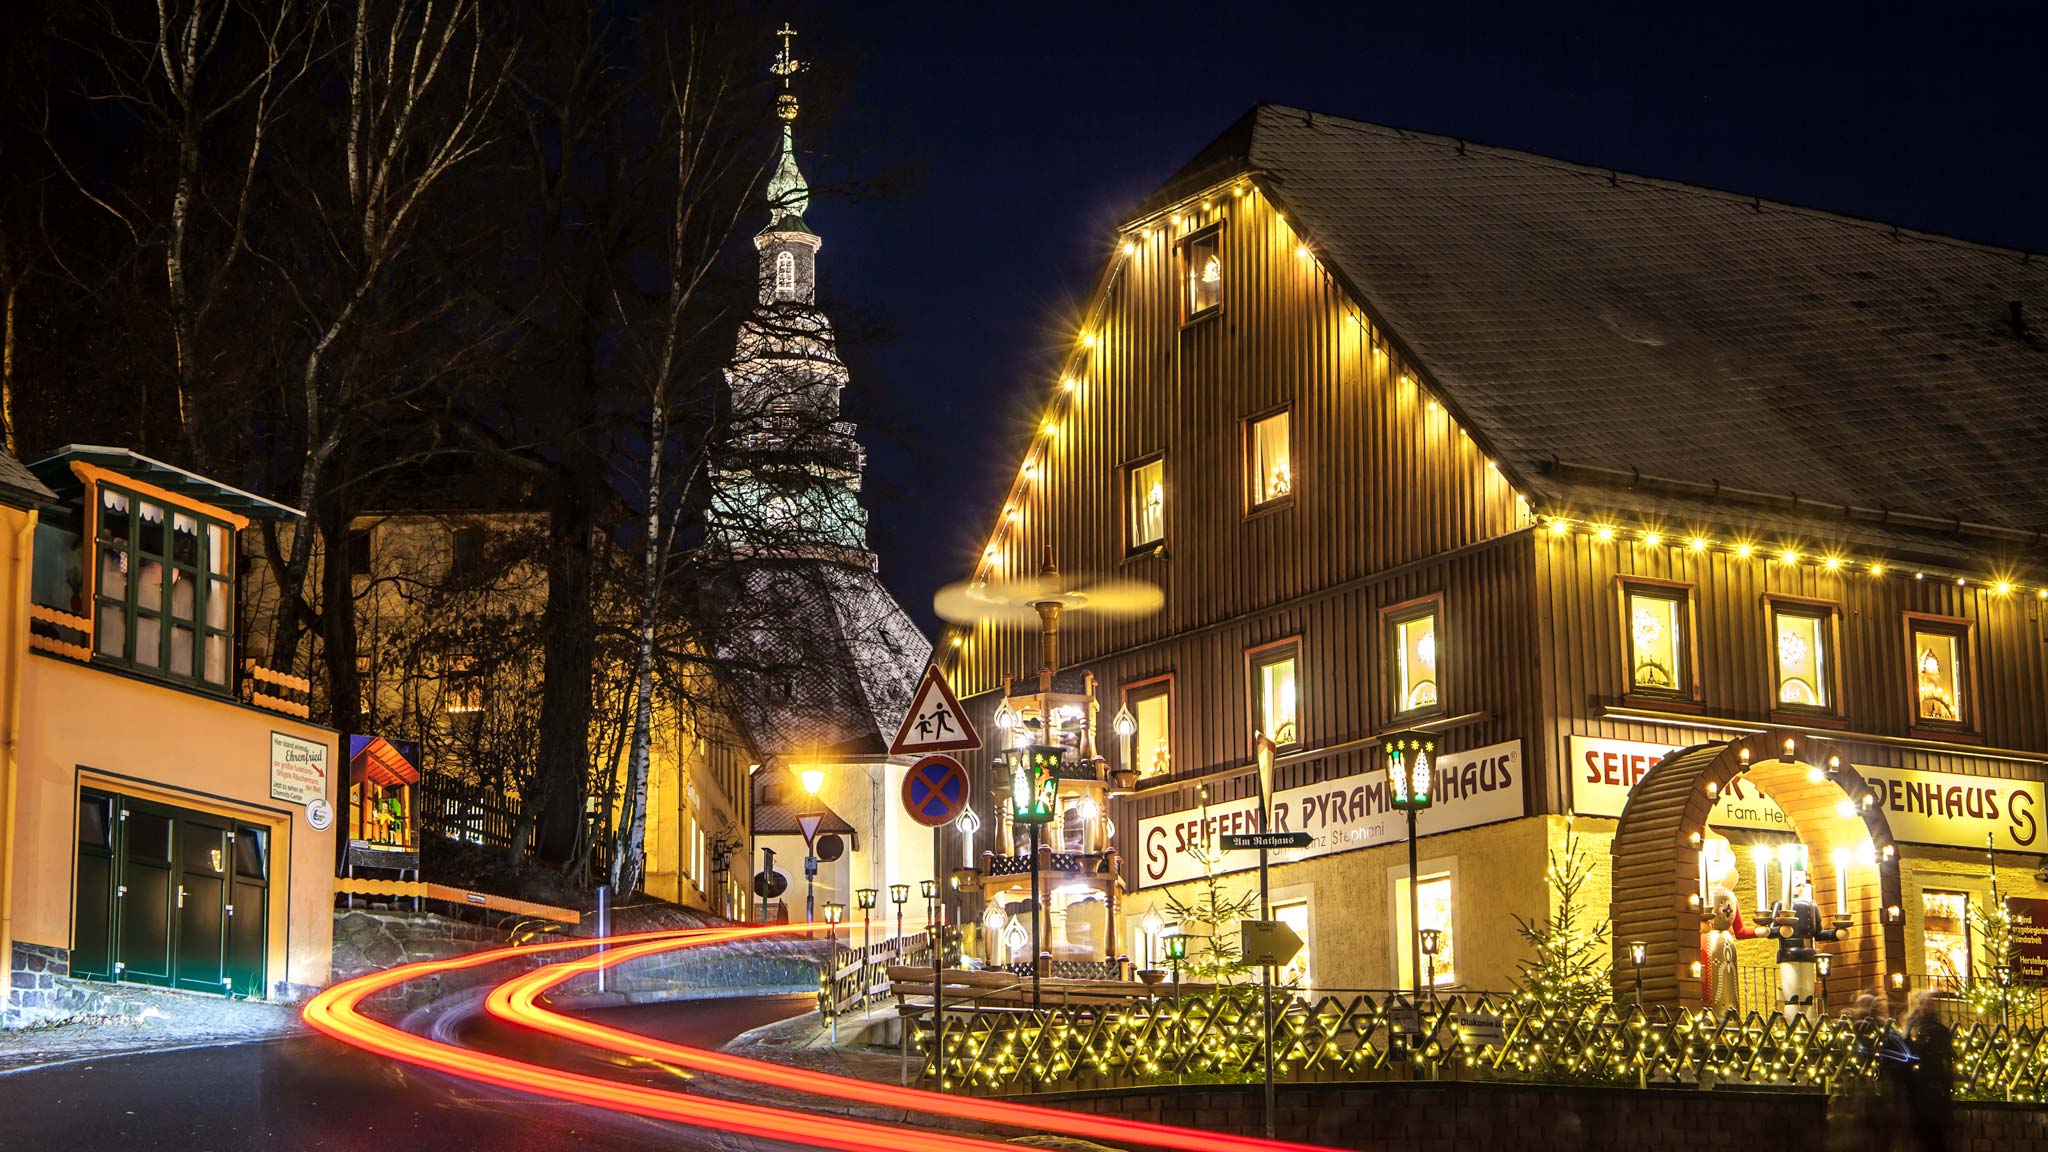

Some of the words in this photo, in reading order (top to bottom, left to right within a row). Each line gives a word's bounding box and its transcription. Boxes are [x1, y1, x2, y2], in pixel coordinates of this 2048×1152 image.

[286, 749, 322, 765] Ehrenfried
[1175, 802, 1291, 853] SEIFFENR
[1302, 755, 1512, 829] PYRAMINHAUS
[1726, 803, 1761, 821] Fam.
[1233, 837, 1250, 846] Am
[1253, 836, 1295, 848] Rathaus
[1332, 821, 1385, 847] Stephani
[1460, 1018, 1494, 1028] Diakonie
